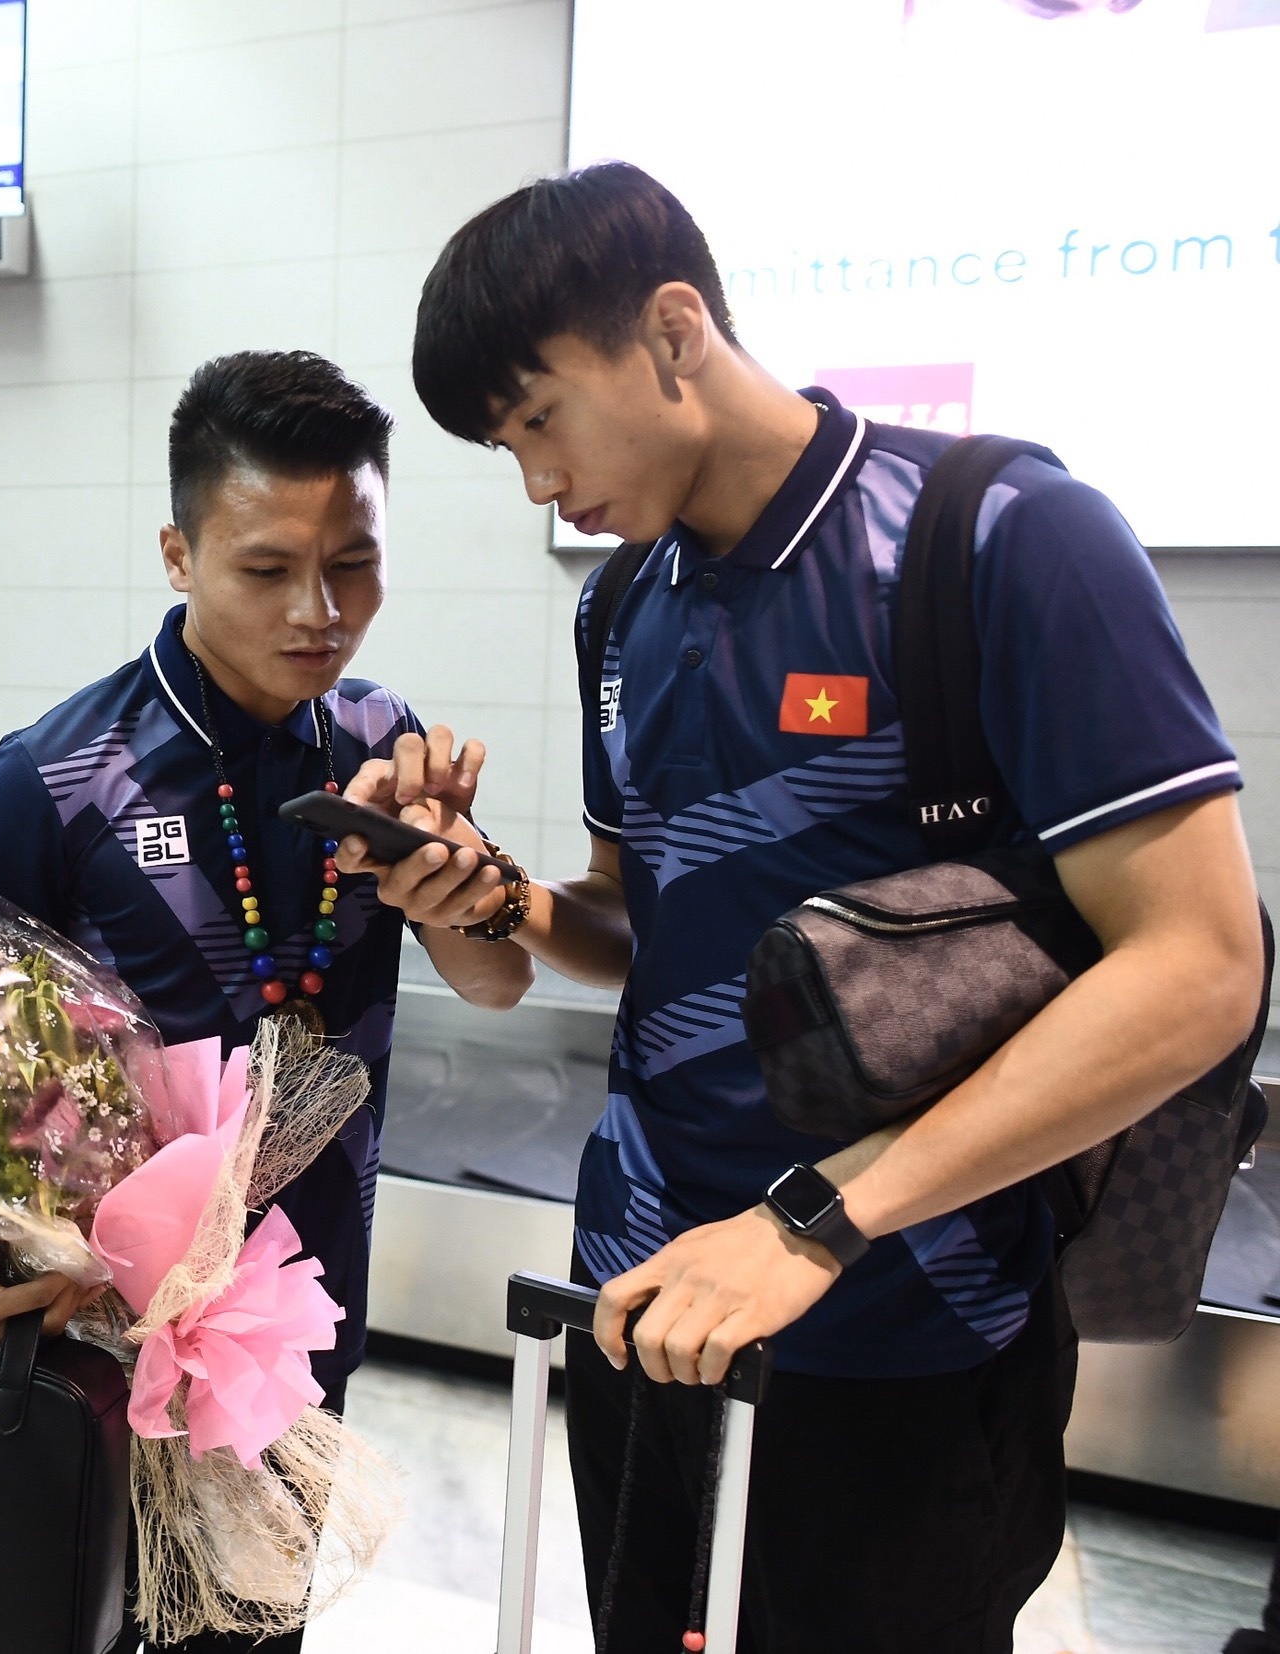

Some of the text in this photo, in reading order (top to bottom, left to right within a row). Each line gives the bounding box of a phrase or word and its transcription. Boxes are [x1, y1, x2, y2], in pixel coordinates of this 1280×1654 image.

[727, 248, 1027, 297] mittance
[1057, 228, 1233, 279] from
[142, 820, 182, 841] JG
[143, 842, 185, 862] BL
